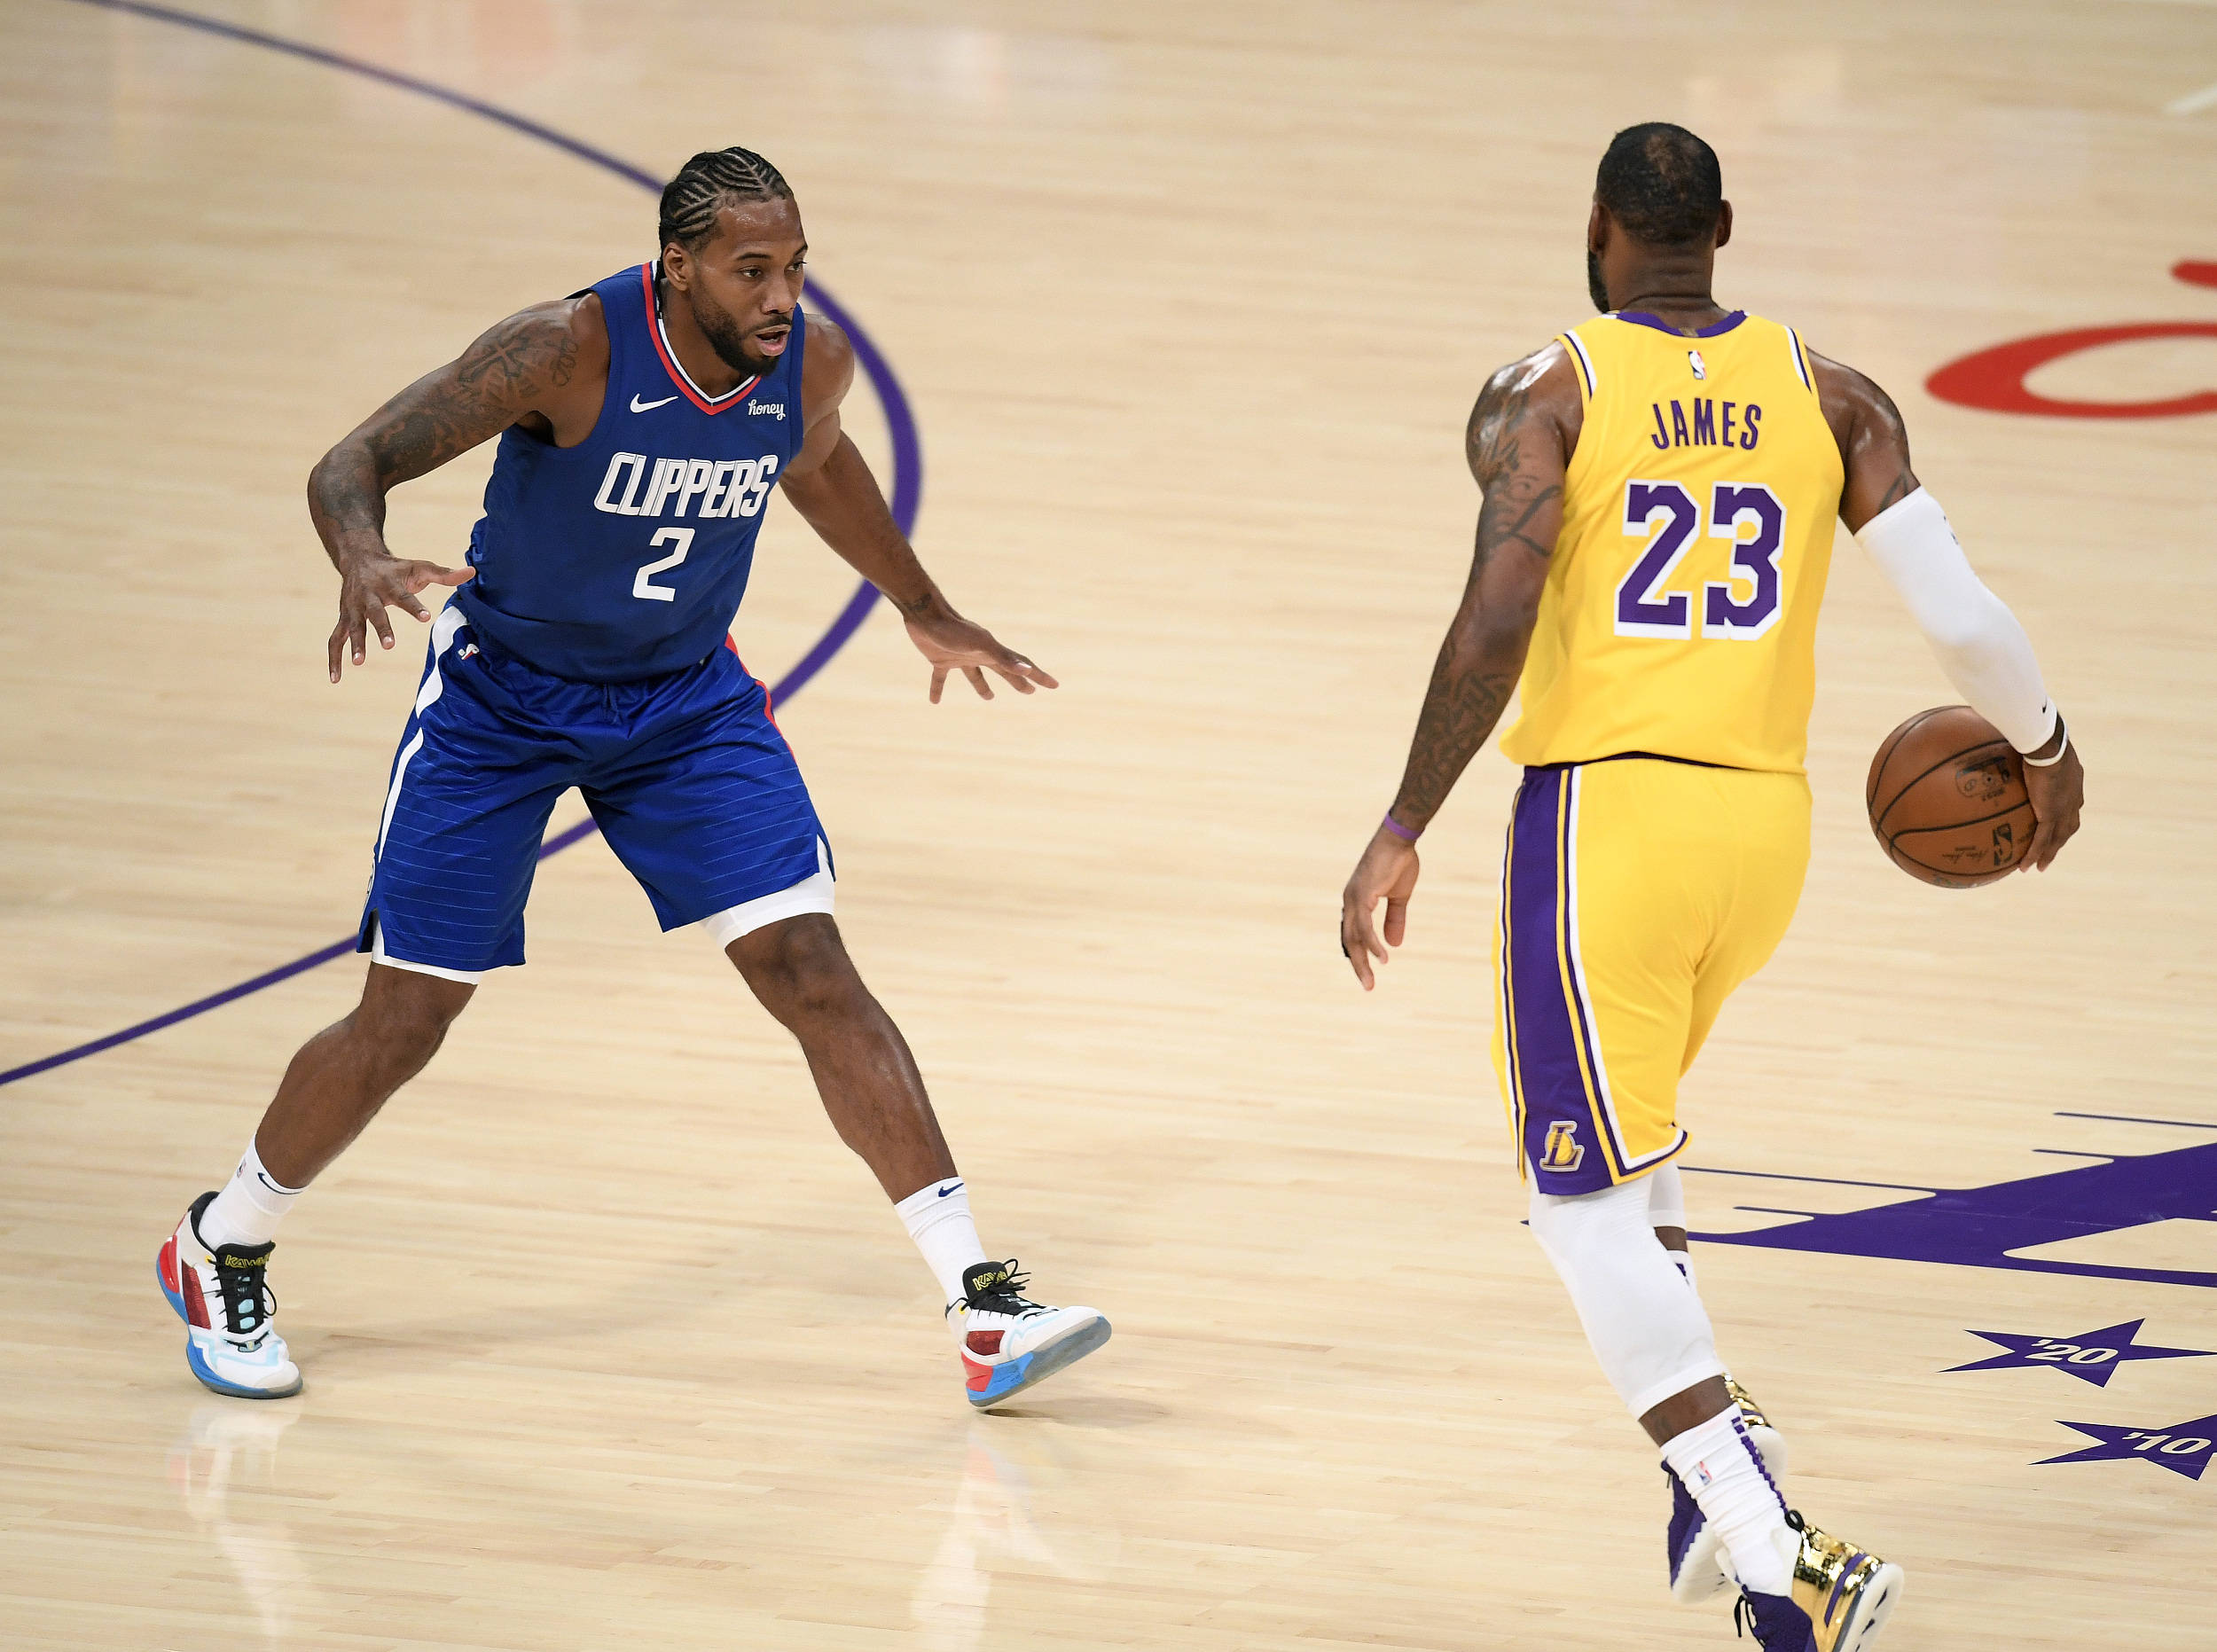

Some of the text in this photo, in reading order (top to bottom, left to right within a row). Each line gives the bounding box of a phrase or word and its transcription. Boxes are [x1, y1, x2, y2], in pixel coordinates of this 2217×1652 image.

[748, 399, 786, 421] honey
[1650, 397, 1762, 450] JAMES
[593, 451, 779, 519] CLIPPERS
[632, 527, 695, 602] 2
[1613, 478, 1788, 641] 23
[2025, 1338, 2119, 1365] '20
[2121, 1431, 2213, 1455] '10
